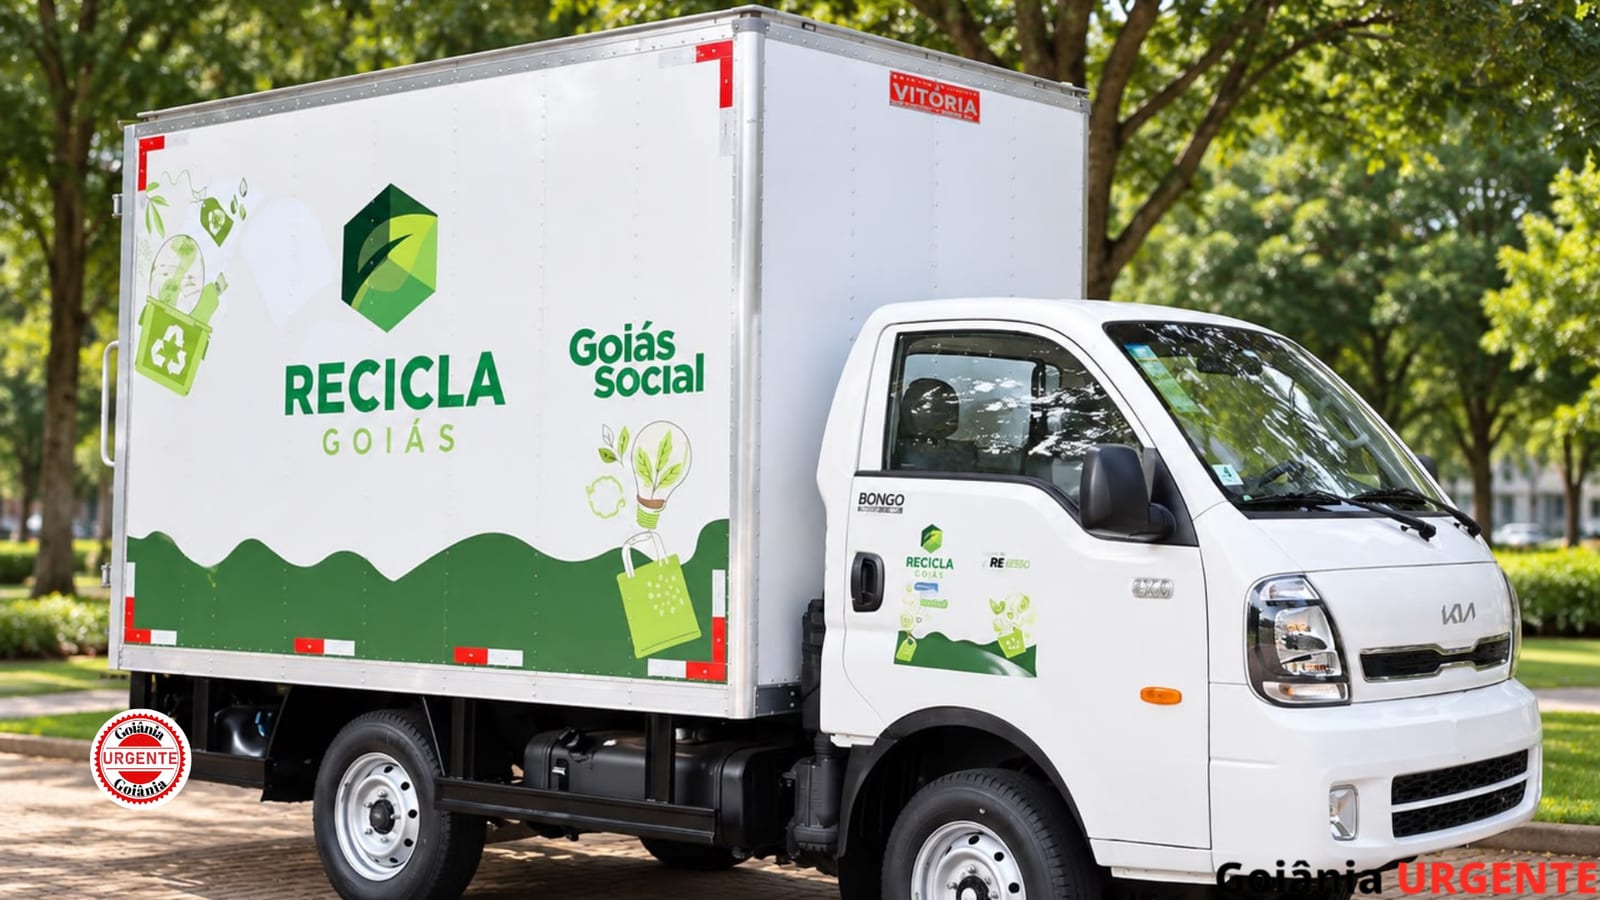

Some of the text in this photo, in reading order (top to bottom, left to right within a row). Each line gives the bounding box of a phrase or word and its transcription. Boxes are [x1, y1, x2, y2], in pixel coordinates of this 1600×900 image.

[892, 82, 978, 116] VITÓRIA
[569, 320, 676, 366] Goiás
[285, 351, 505, 416] RECICLA
[322, 417, 455, 456] GOIÁS
[858, 492, 905, 506] BONGO
[906, 556, 954, 570] RECICLA
[1441, 602, 1476, 624] KIA
